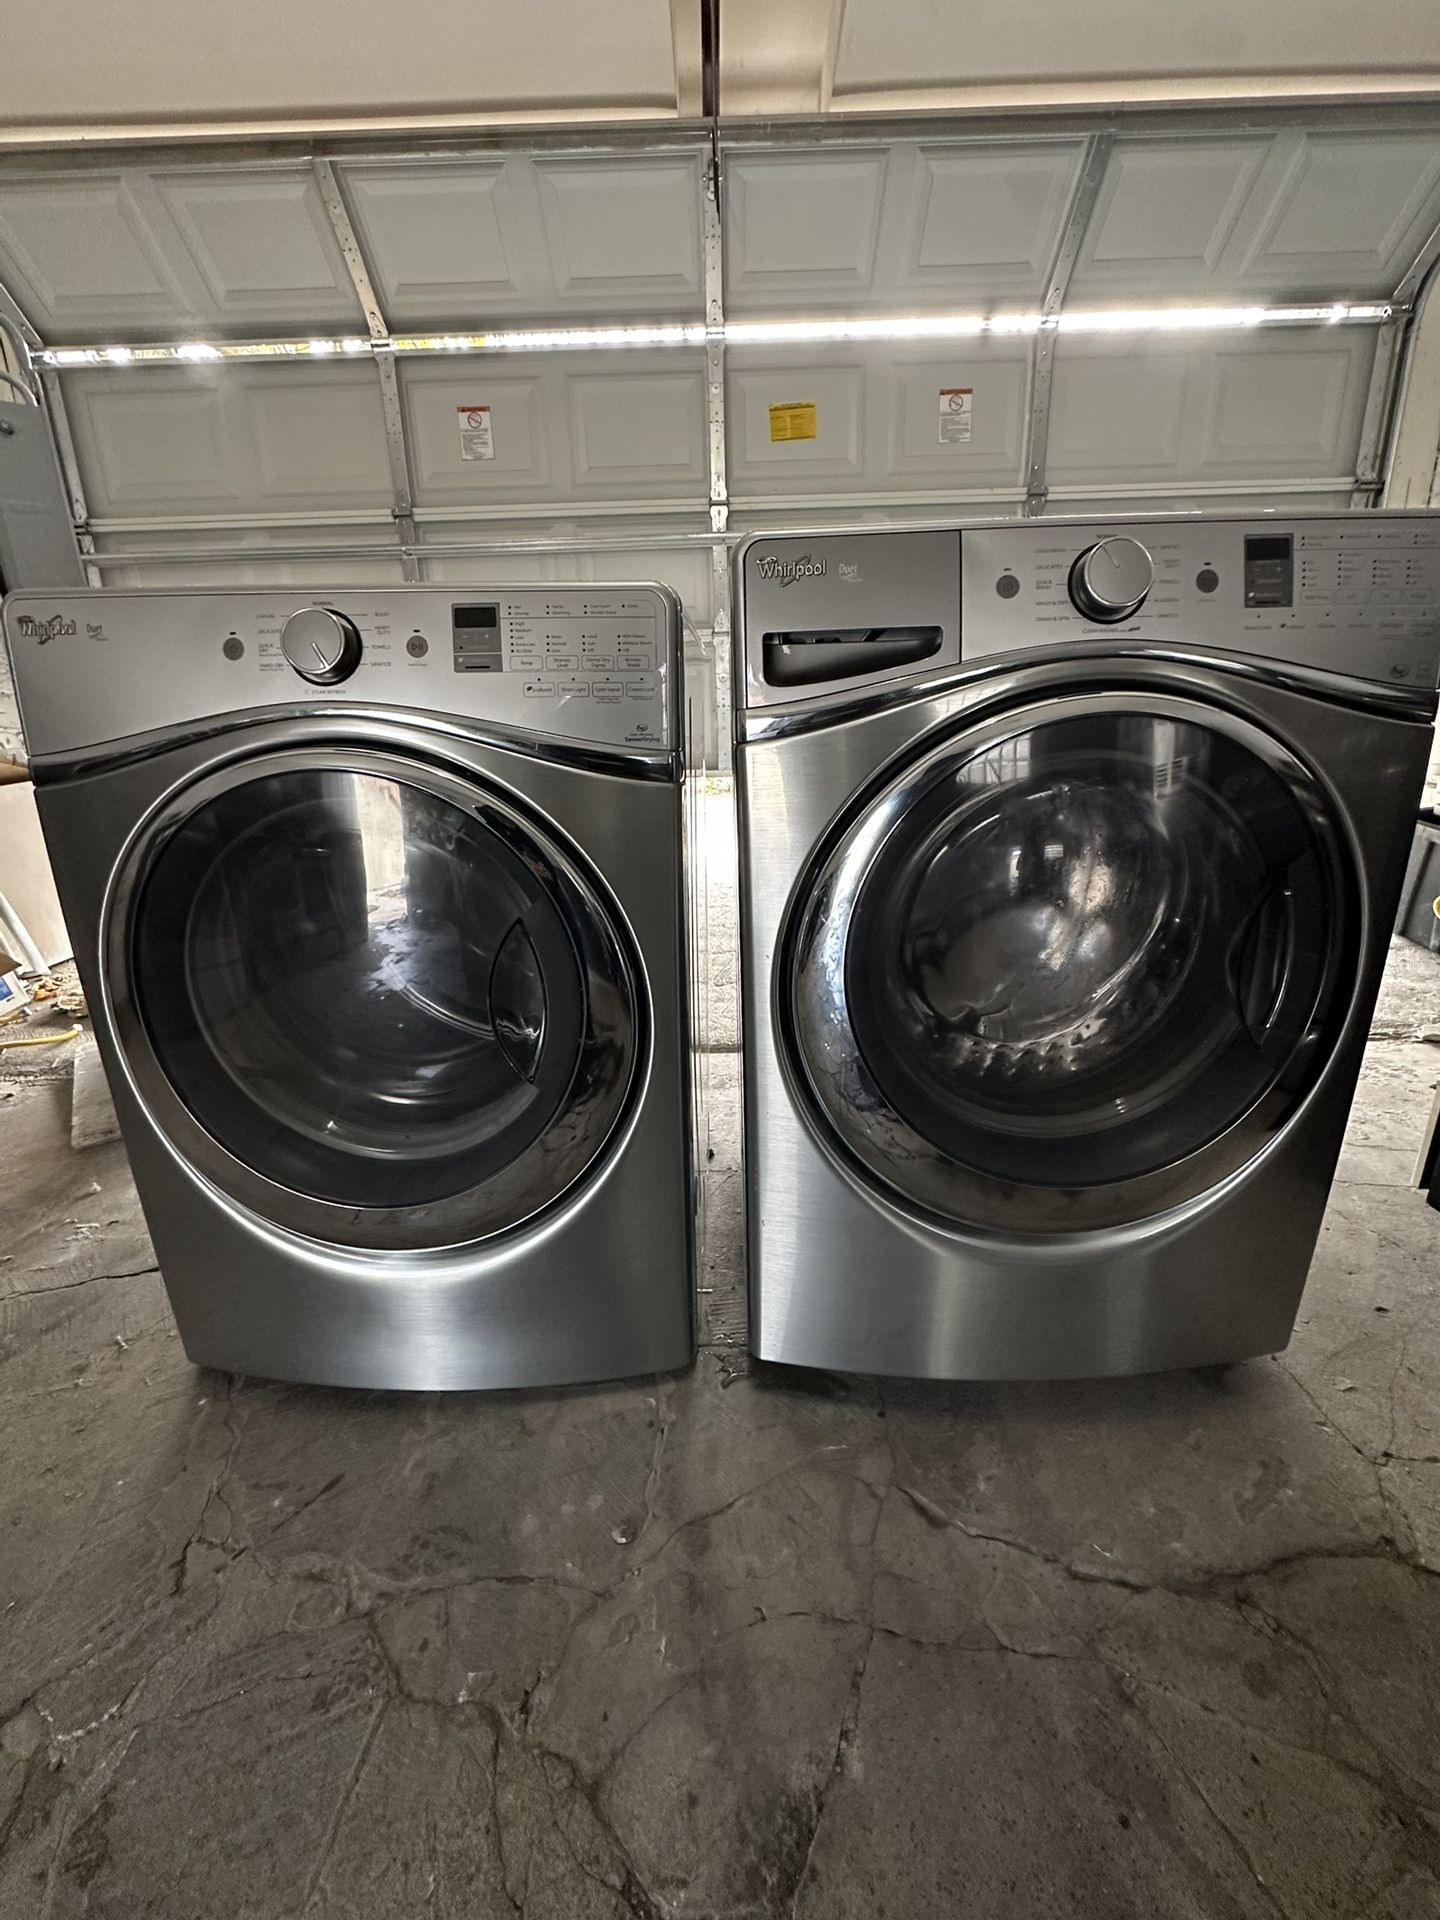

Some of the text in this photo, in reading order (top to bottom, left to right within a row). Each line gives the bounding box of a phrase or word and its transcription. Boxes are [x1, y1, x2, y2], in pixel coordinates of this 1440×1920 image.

[757, 555, 858, 584] Whirlpool Duet
[17, 616, 77, 642] Whirlpool
